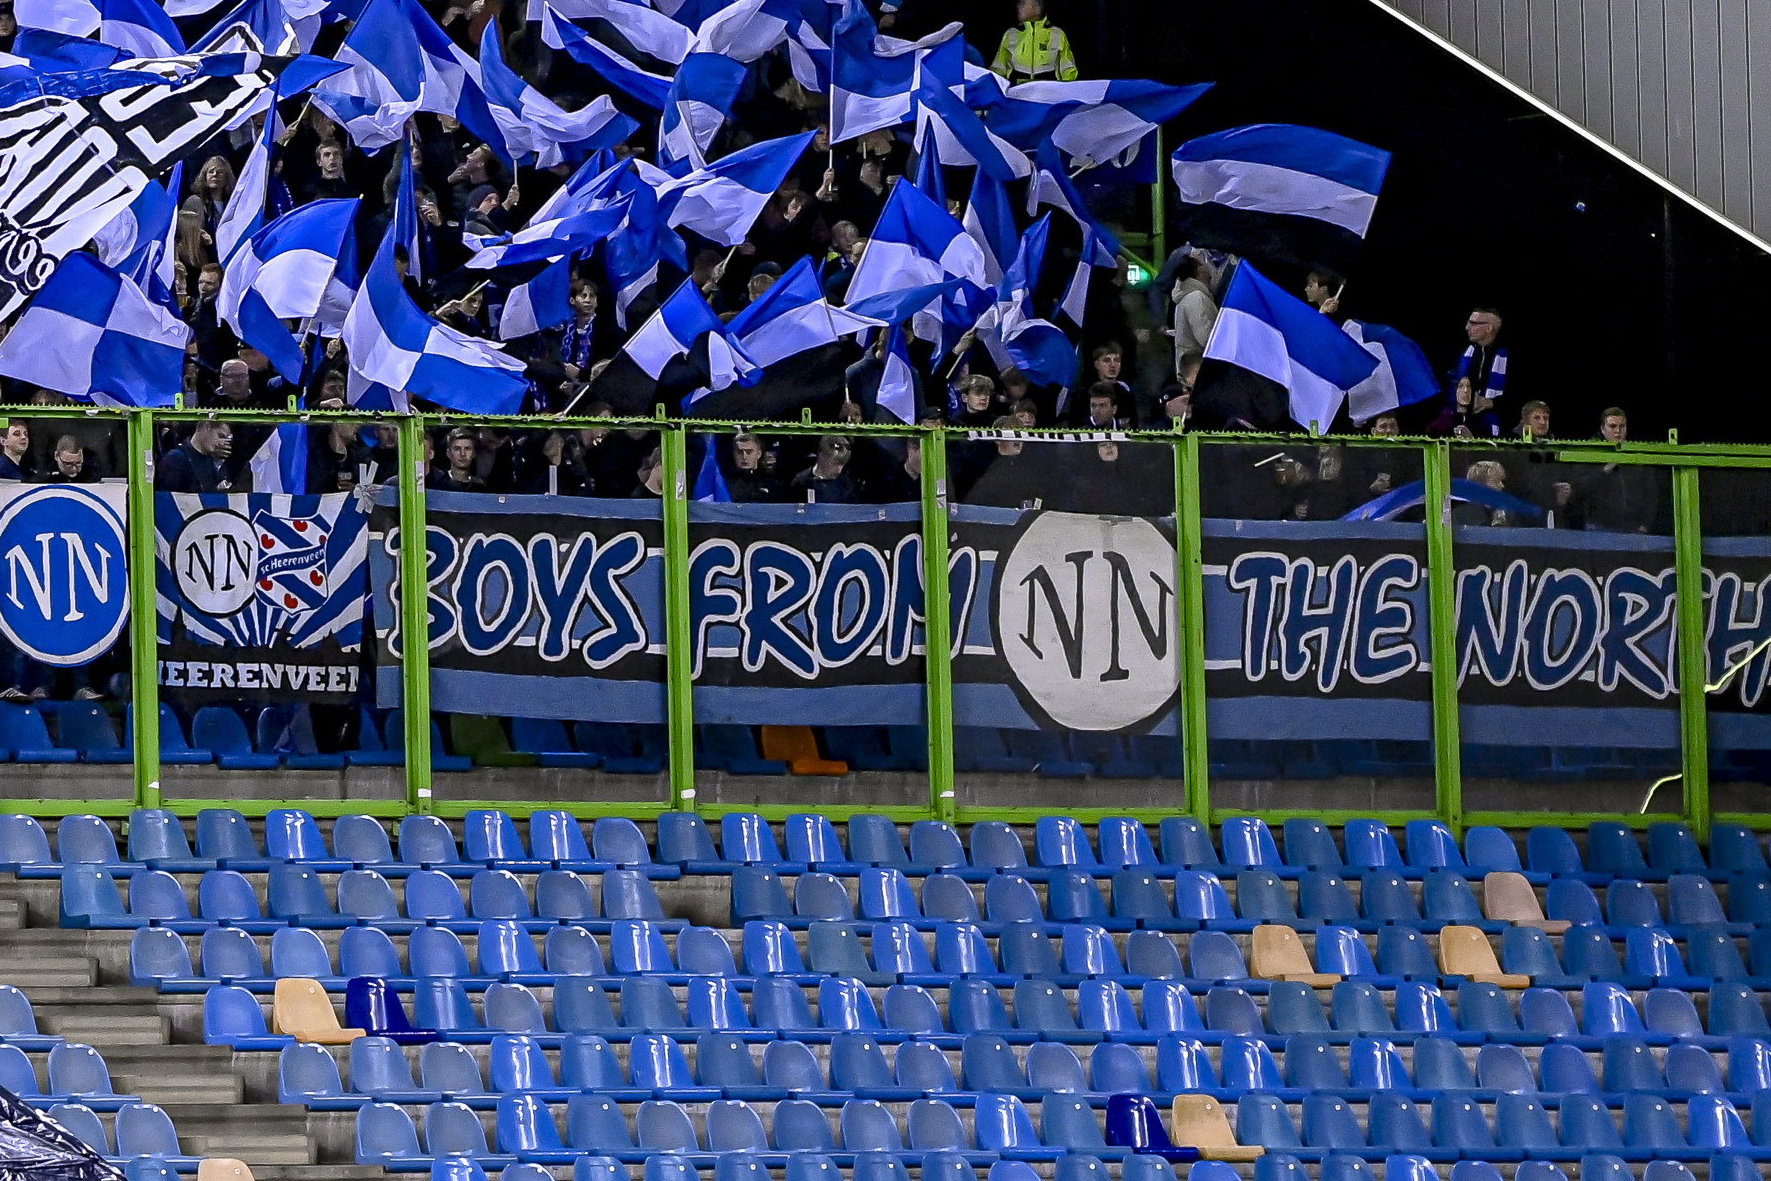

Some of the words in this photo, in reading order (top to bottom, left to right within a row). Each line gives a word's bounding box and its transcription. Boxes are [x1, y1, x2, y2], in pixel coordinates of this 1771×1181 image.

[4, 531, 112, 622] NN
[185, 533, 254, 592] NN
[271, 548, 326, 570] Heerenveen
[385, 524, 648, 671] BOYS
[688, 532, 980, 681] FROM
[1229, 550, 1419, 694] THE
[1018, 549, 1175, 683] NN
